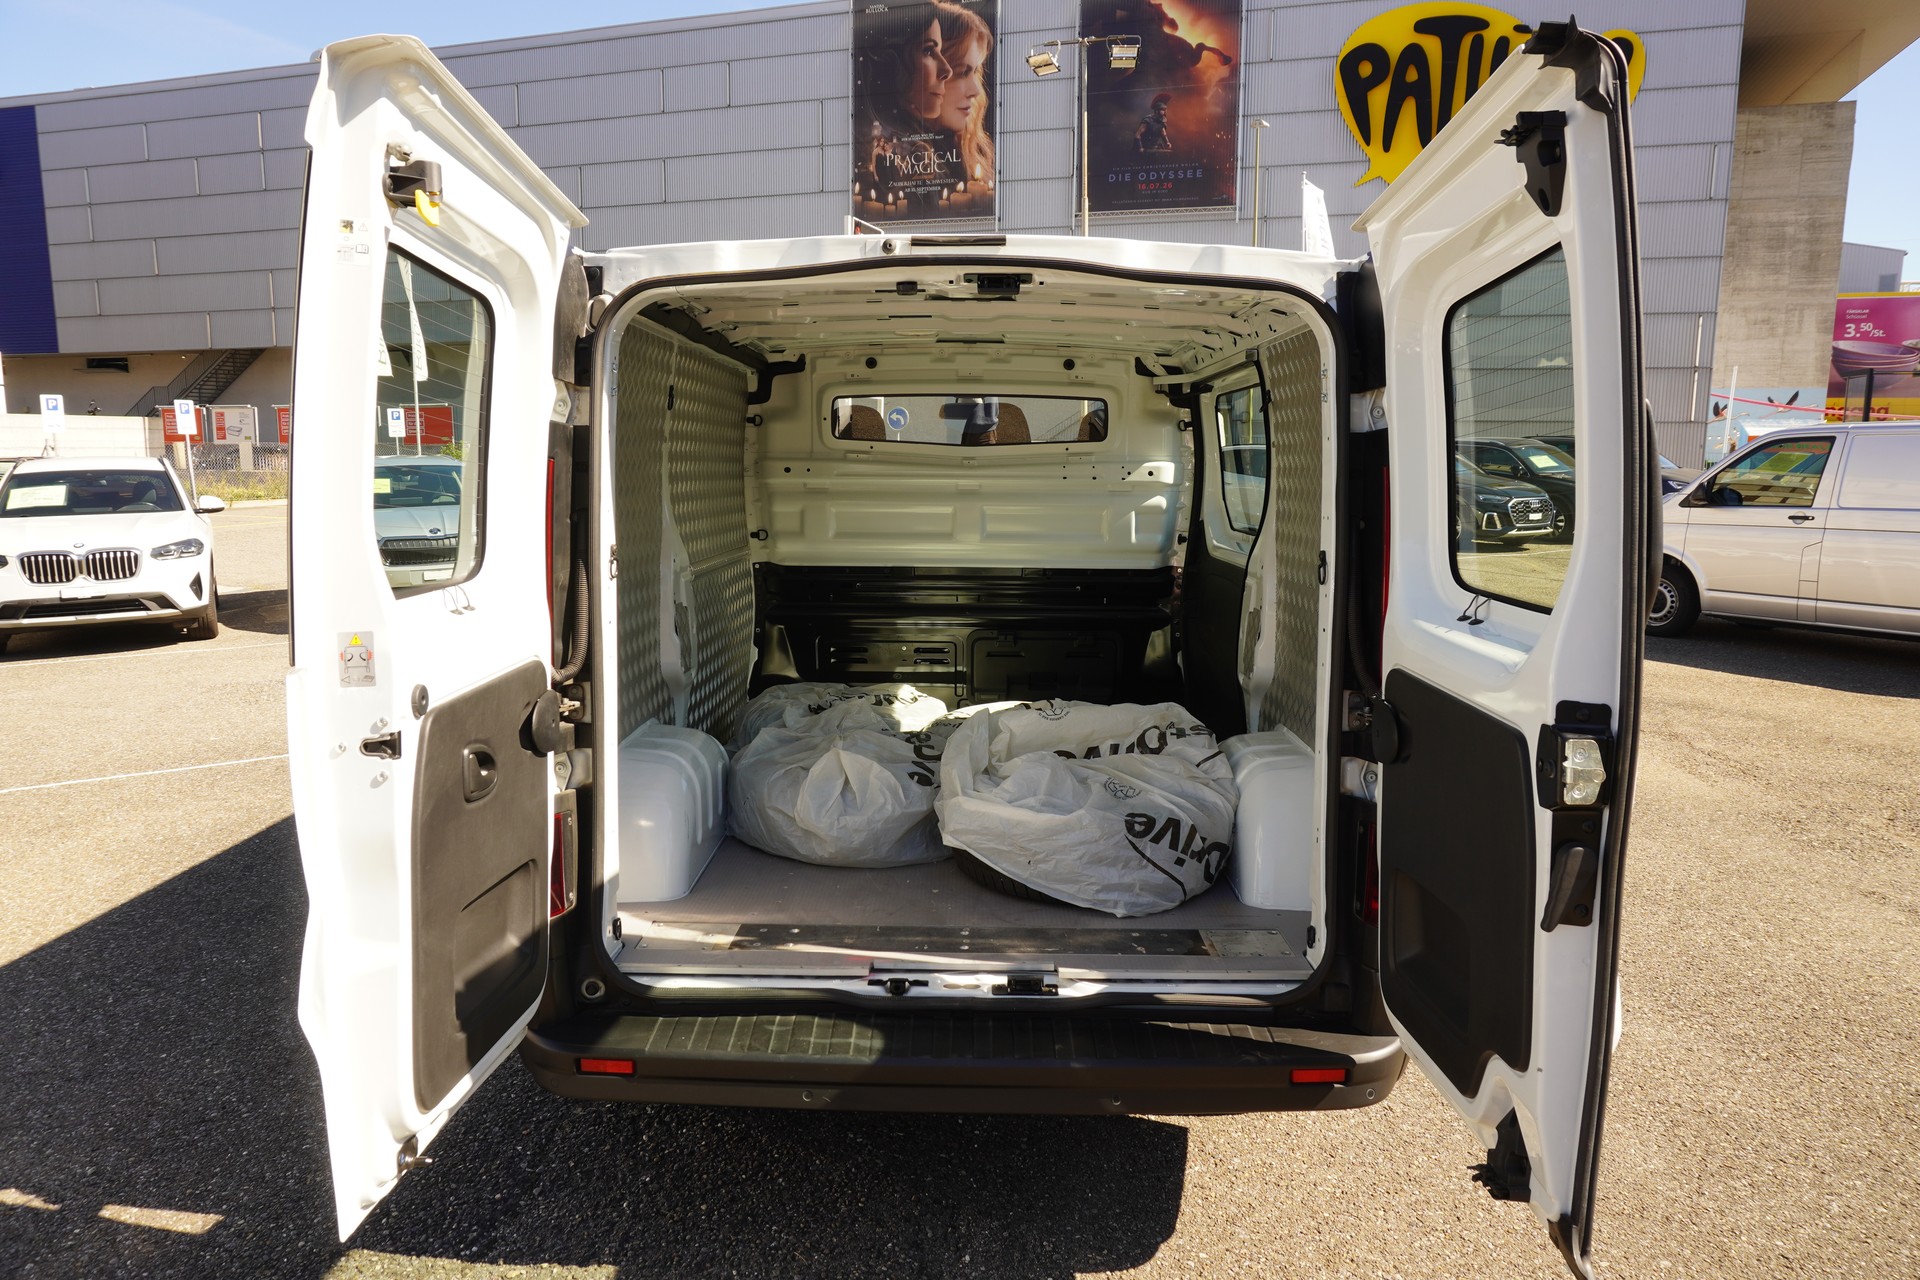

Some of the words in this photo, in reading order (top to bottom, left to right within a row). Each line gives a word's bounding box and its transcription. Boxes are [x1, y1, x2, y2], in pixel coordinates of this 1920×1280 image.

[886, 148, 961, 167] PRACTICAL
[901, 160, 946, 175] MAGIC
[1108, 173, 1131, 182] DIE
[1138, 169, 1204, 181] ODYSSEE
[1138, 182, 1173, 190] 16.07.26
[1124, 812, 1230, 884] Drive
